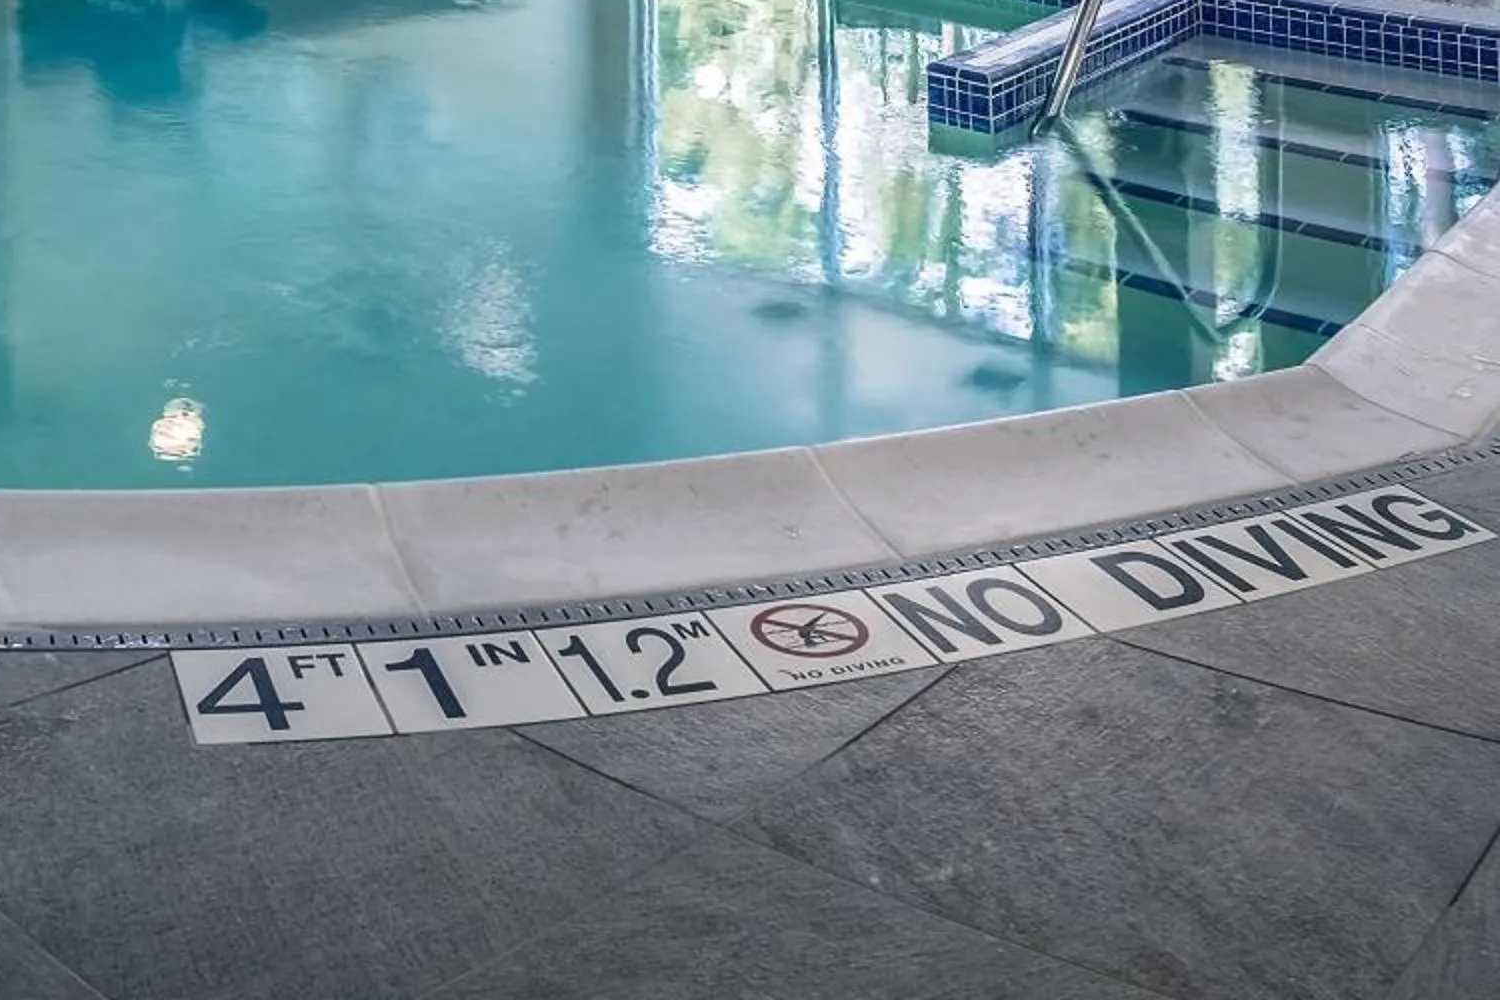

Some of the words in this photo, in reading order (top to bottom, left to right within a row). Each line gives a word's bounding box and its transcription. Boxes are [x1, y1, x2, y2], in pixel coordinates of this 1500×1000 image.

[883, 577, 1064, 655] NO
[1090, 494, 1480, 612] DIVING
[197, 656, 305, 730] 4
[287, 653, 346, 679] FT
[384, 647, 467, 719] 1
[465, 640, 531, 668] IN
[558, 626, 717, 703] 1.2
[670, 619, 711, 643] M
[779, 669, 823, 681] NO
[829, 656, 905, 675] DIVING
